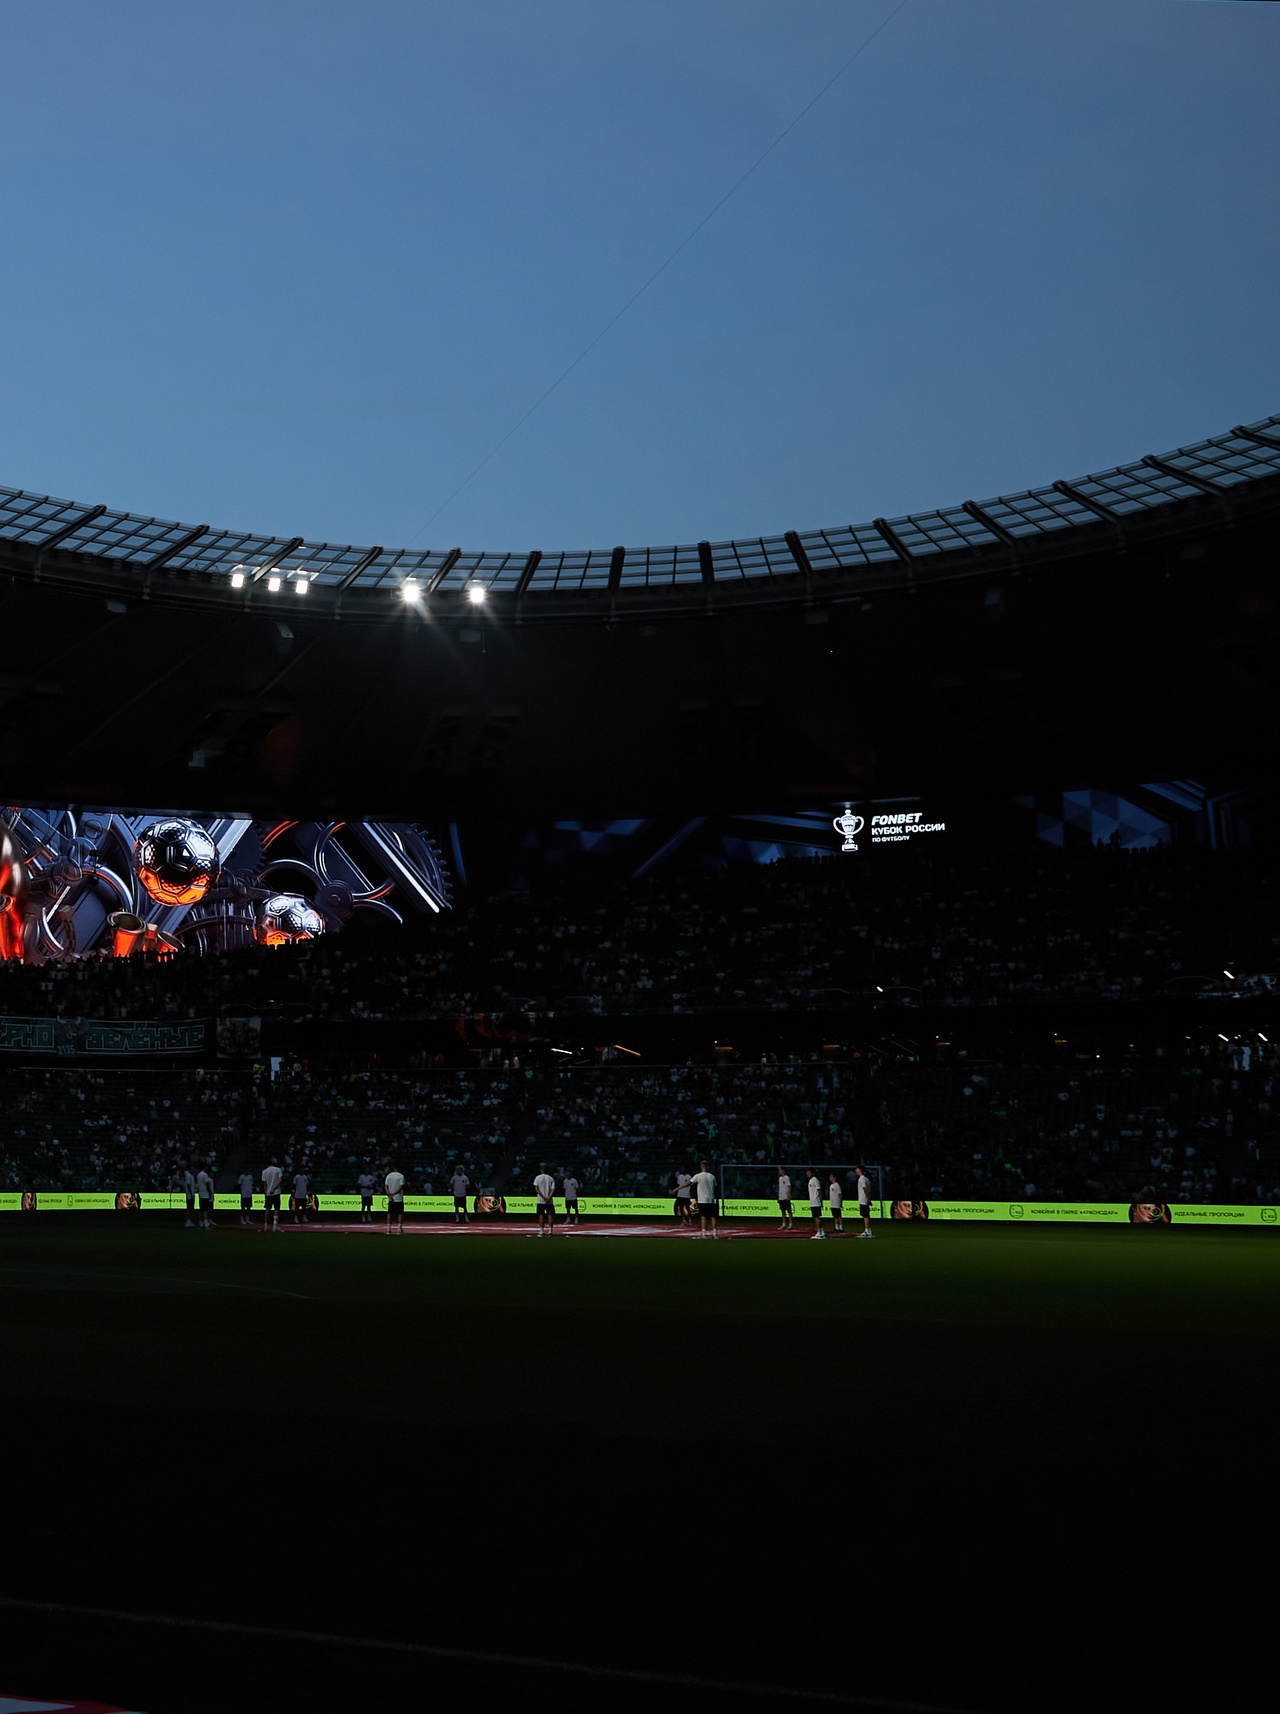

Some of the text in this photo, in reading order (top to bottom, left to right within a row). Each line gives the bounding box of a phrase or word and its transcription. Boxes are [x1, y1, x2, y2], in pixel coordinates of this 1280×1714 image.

[871, 812, 923, 826] FONBET
[871, 822, 946, 836] КУБОК РОССИИ
